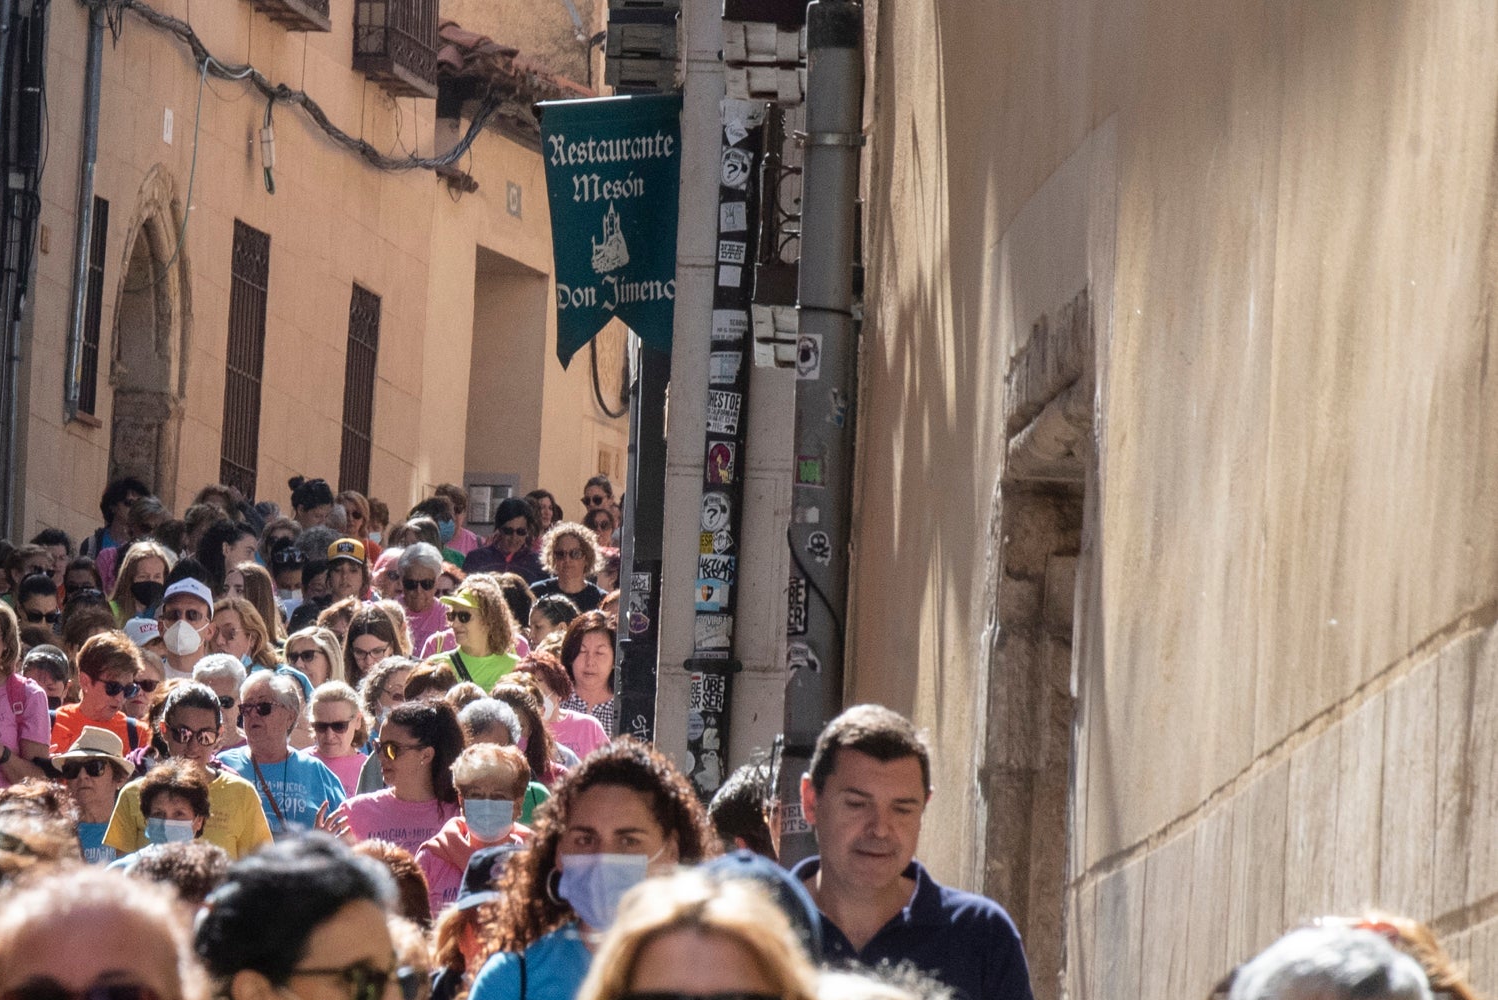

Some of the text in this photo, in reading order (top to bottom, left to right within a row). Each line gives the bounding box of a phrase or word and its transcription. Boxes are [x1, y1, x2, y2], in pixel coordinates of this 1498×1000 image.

[548, 130, 674, 167] Restaurante
[572, 171, 644, 202] Mesón
[556, 283, 597, 310] Don
